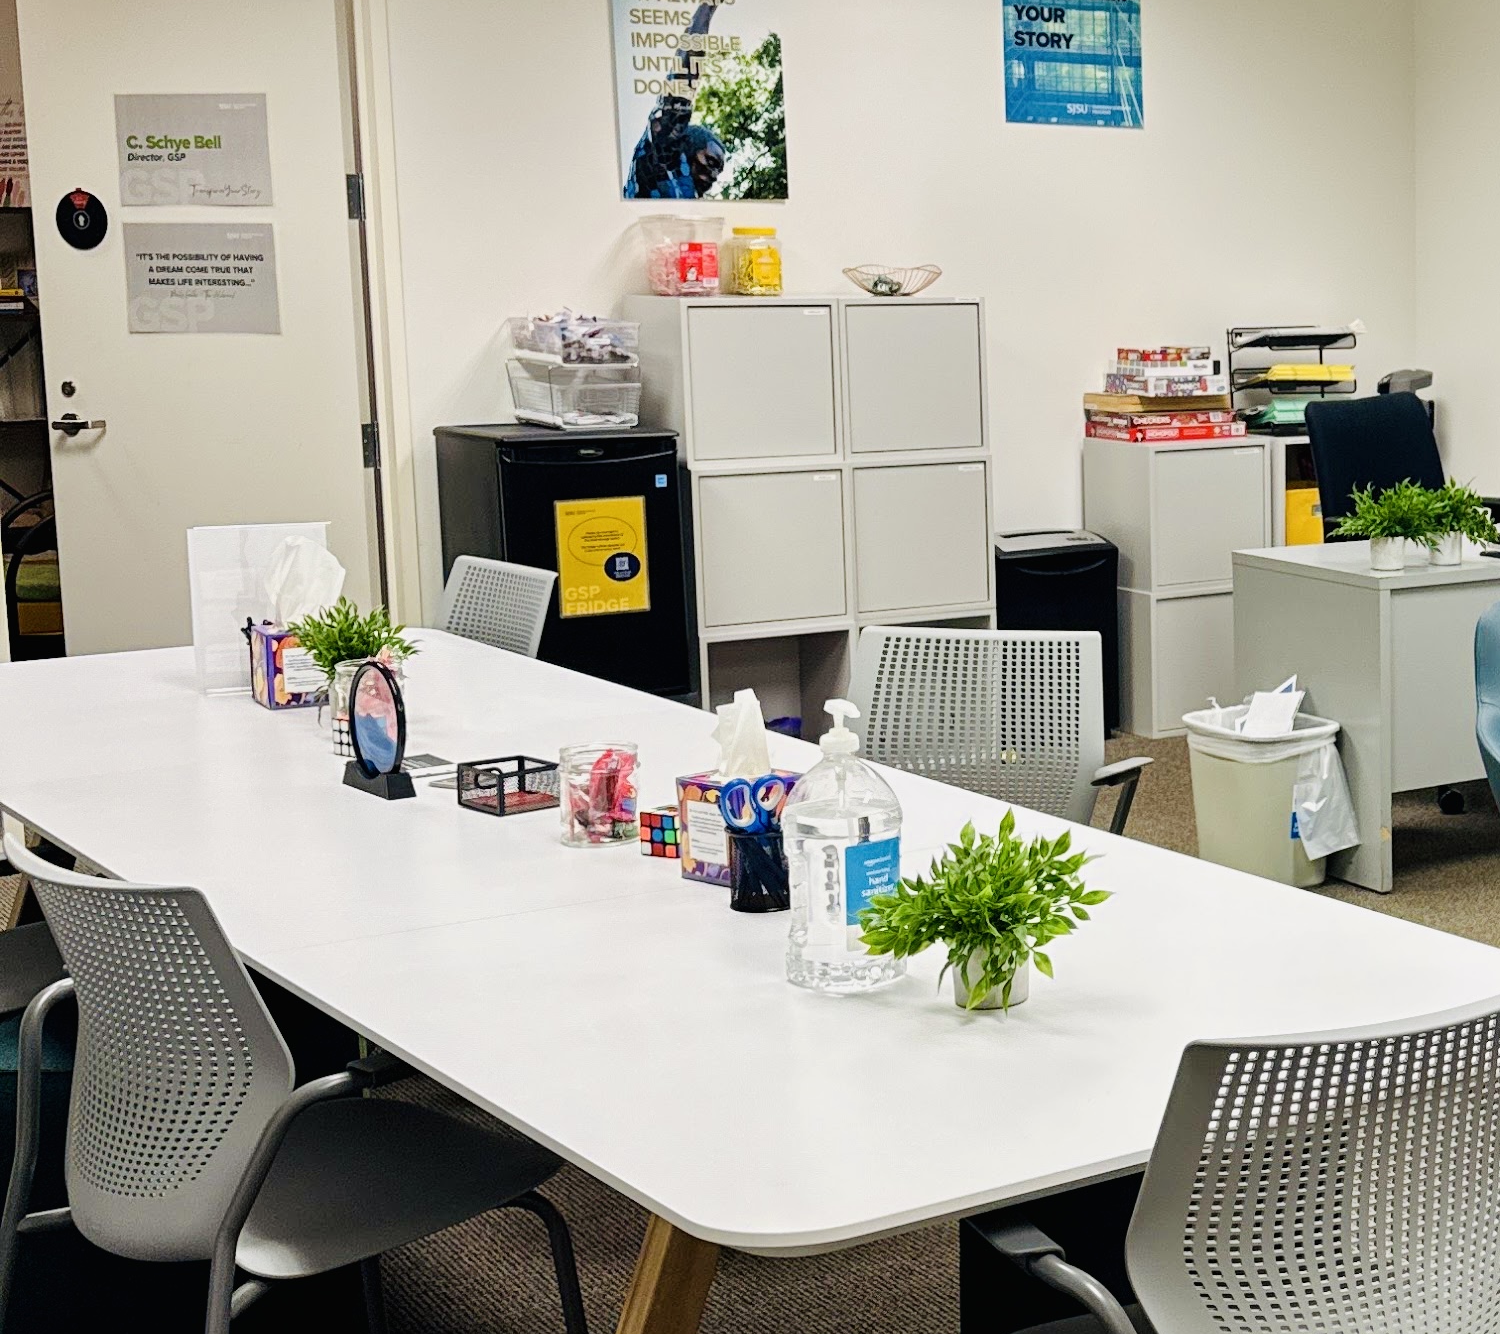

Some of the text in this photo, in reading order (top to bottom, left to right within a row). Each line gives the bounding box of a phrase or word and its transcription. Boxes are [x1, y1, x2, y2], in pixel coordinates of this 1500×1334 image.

[629, 8, 691, 26] SEEMS
[1013, 4, 1065, 23] YOUR
[631, 32, 741, 51] IMPOSSIBLE
[1014, 30, 1074, 49] STORY
[632, 55, 688, 73] UNTIL
[1066, 103, 1088, 116] SJSU
[126, 135, 222, 152] C. Schye Bell
[127, 152, 187, 162] Director, GSP
[155, 253, 170, 262] THE
[172, 253, 219, 262] POSSIBILITY
[220, 254, 231, 262] OF
[232, 254, 264, 262] HAVING
[185, 266, 209, 274] COME
[210, 266, 231, 274] TRUE
[233, 266, 254, 274] THAT
[148, 278, 175, 286] MAKES
[564, 585, 601, 601] GSP
[565, 597, 630, 615] FRIDGE
[868, 873, 889, 886] hand
